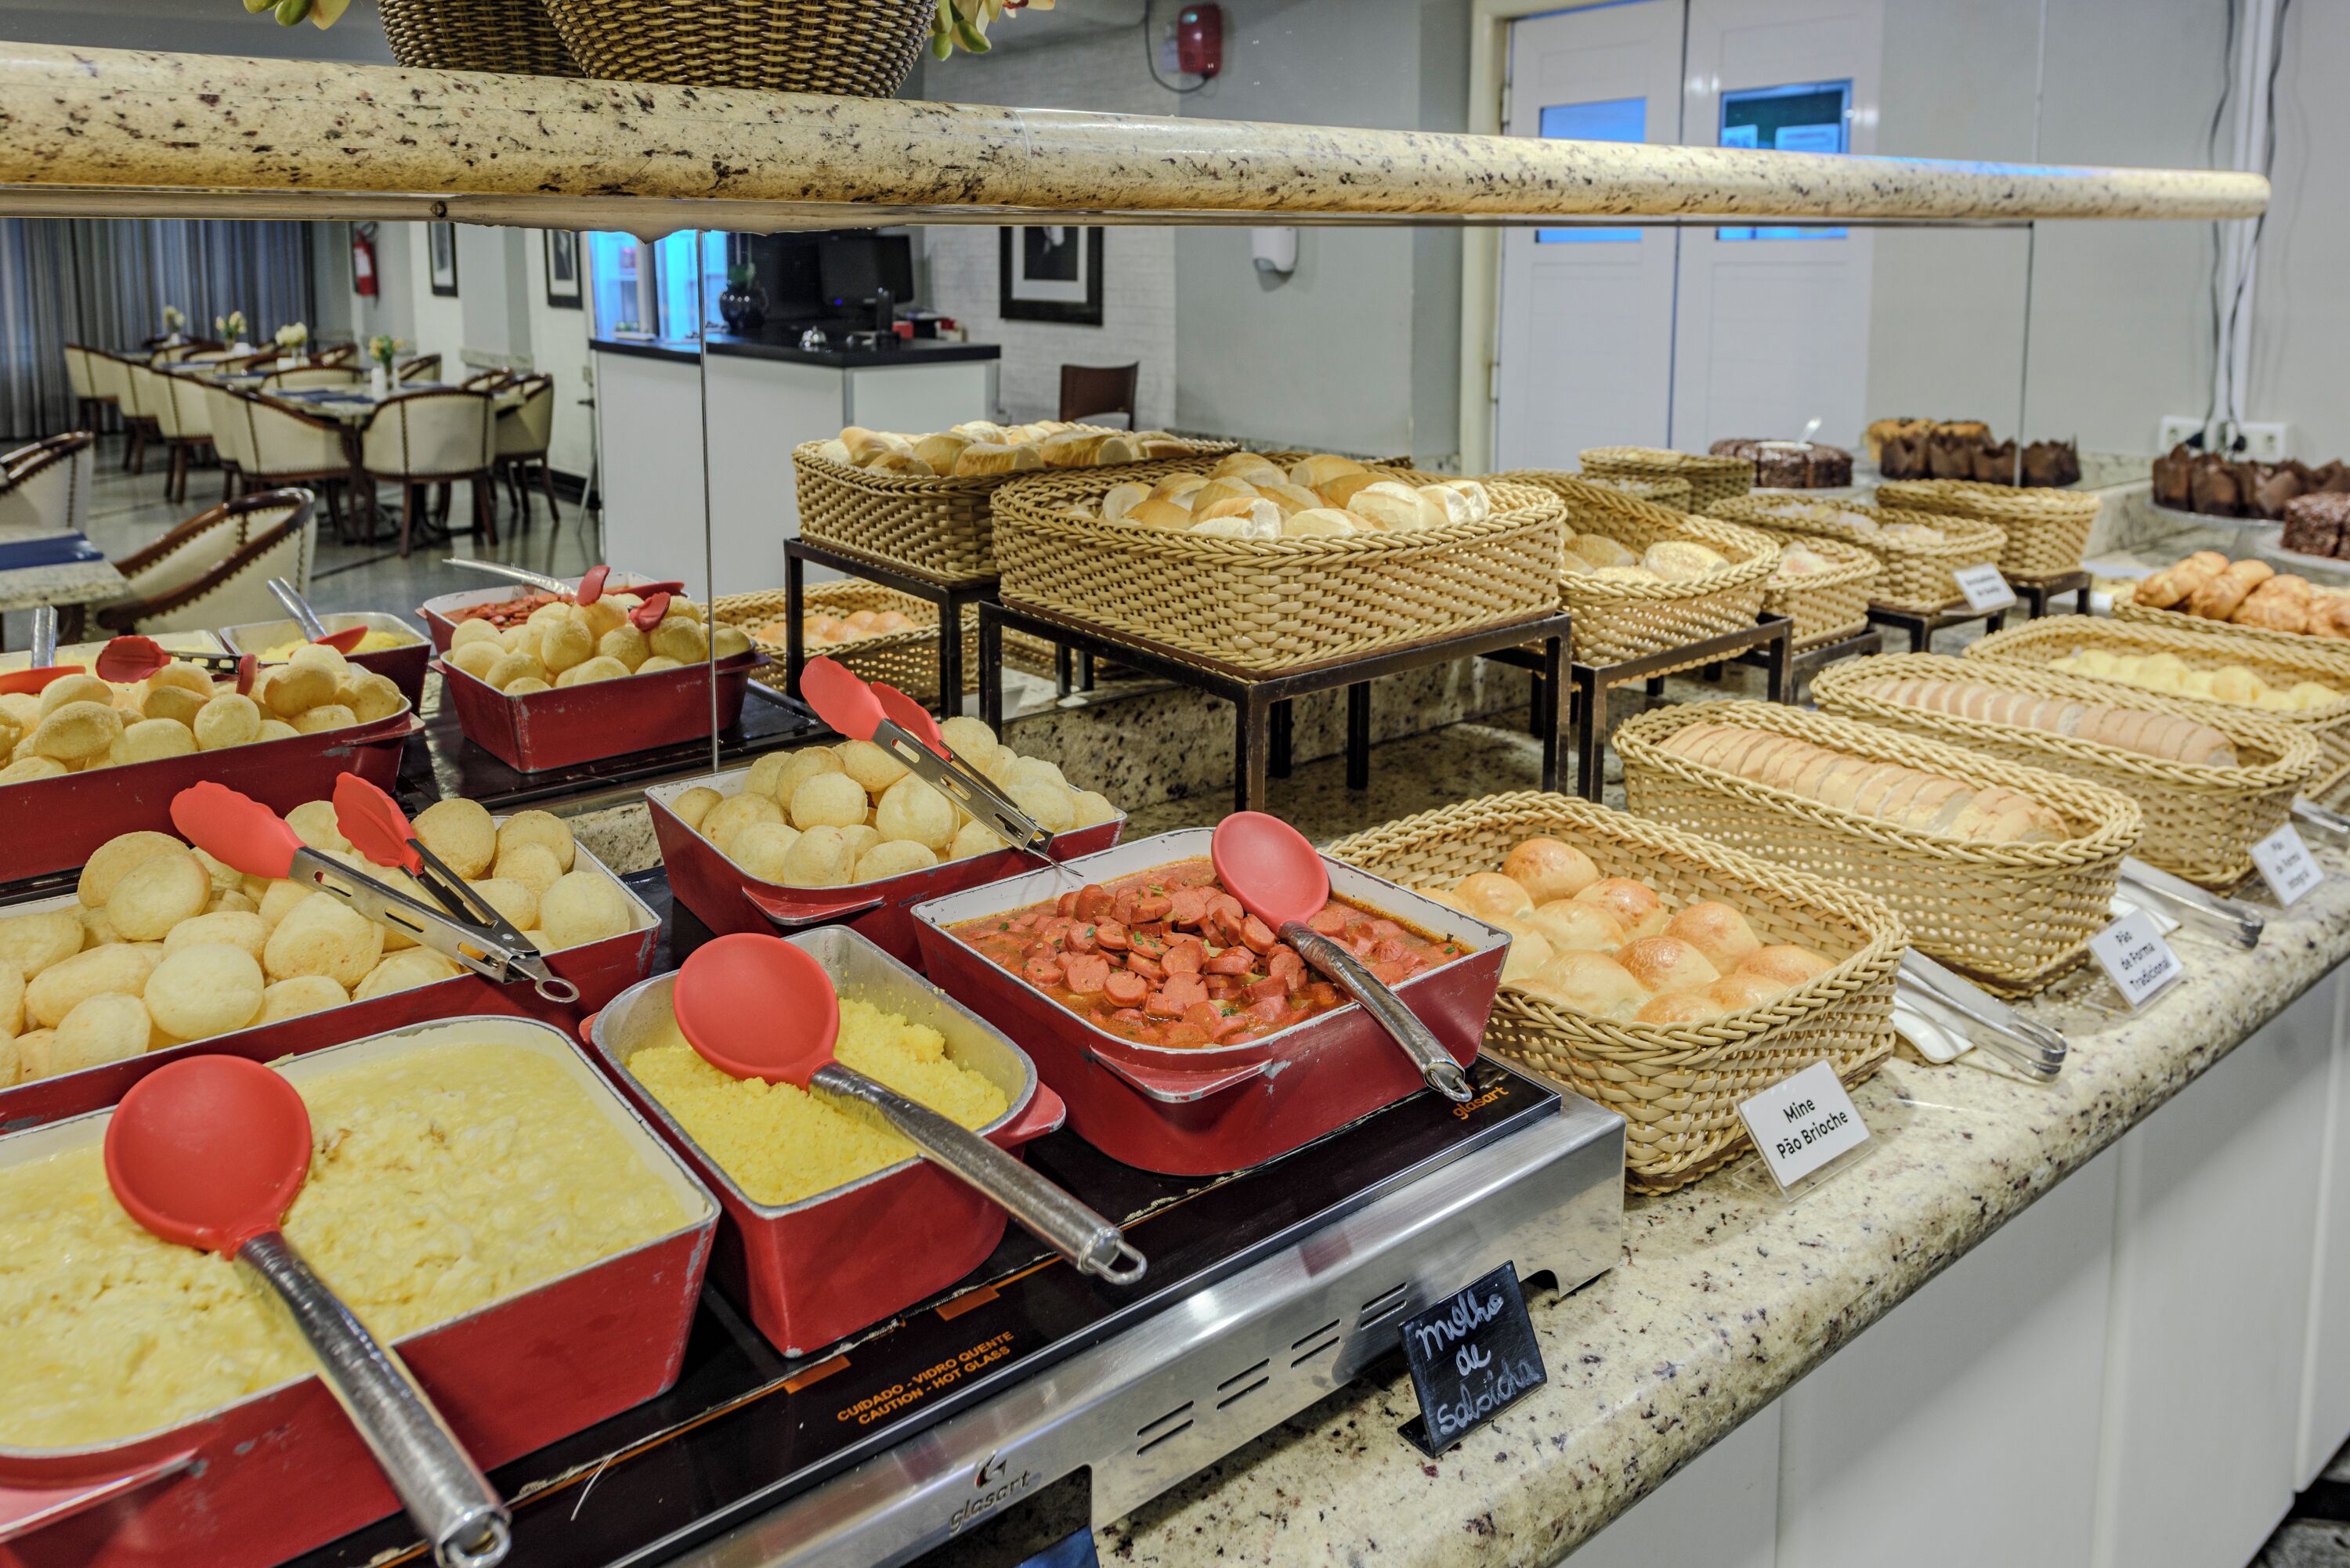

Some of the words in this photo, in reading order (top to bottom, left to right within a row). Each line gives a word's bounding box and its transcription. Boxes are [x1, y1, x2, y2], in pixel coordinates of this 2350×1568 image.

[2129, 942, 2156, 963] Forma
[2129, 955, 2171, 991] Tradicional
[1452, 1086, 1509, 1120] glasart
[1783, 1098, 1816, 1123] Mine
[1775, 1137, 1802, 1159] Pão
[1801, 1111, 1849, 1145] Brioche
[912, 1357, 958, 1385] VIDRO
[958, 1331, 1014, 1362] QUENTE
[1455, 1344, 1492, 1377] de
[858, 1387, 924, 1425] CAUTION
[933, 1367, 963, 1390] HOT
[964, 1345, 1011, 1373] GLASS
[949, 1469, 1031, 1537] glasart
